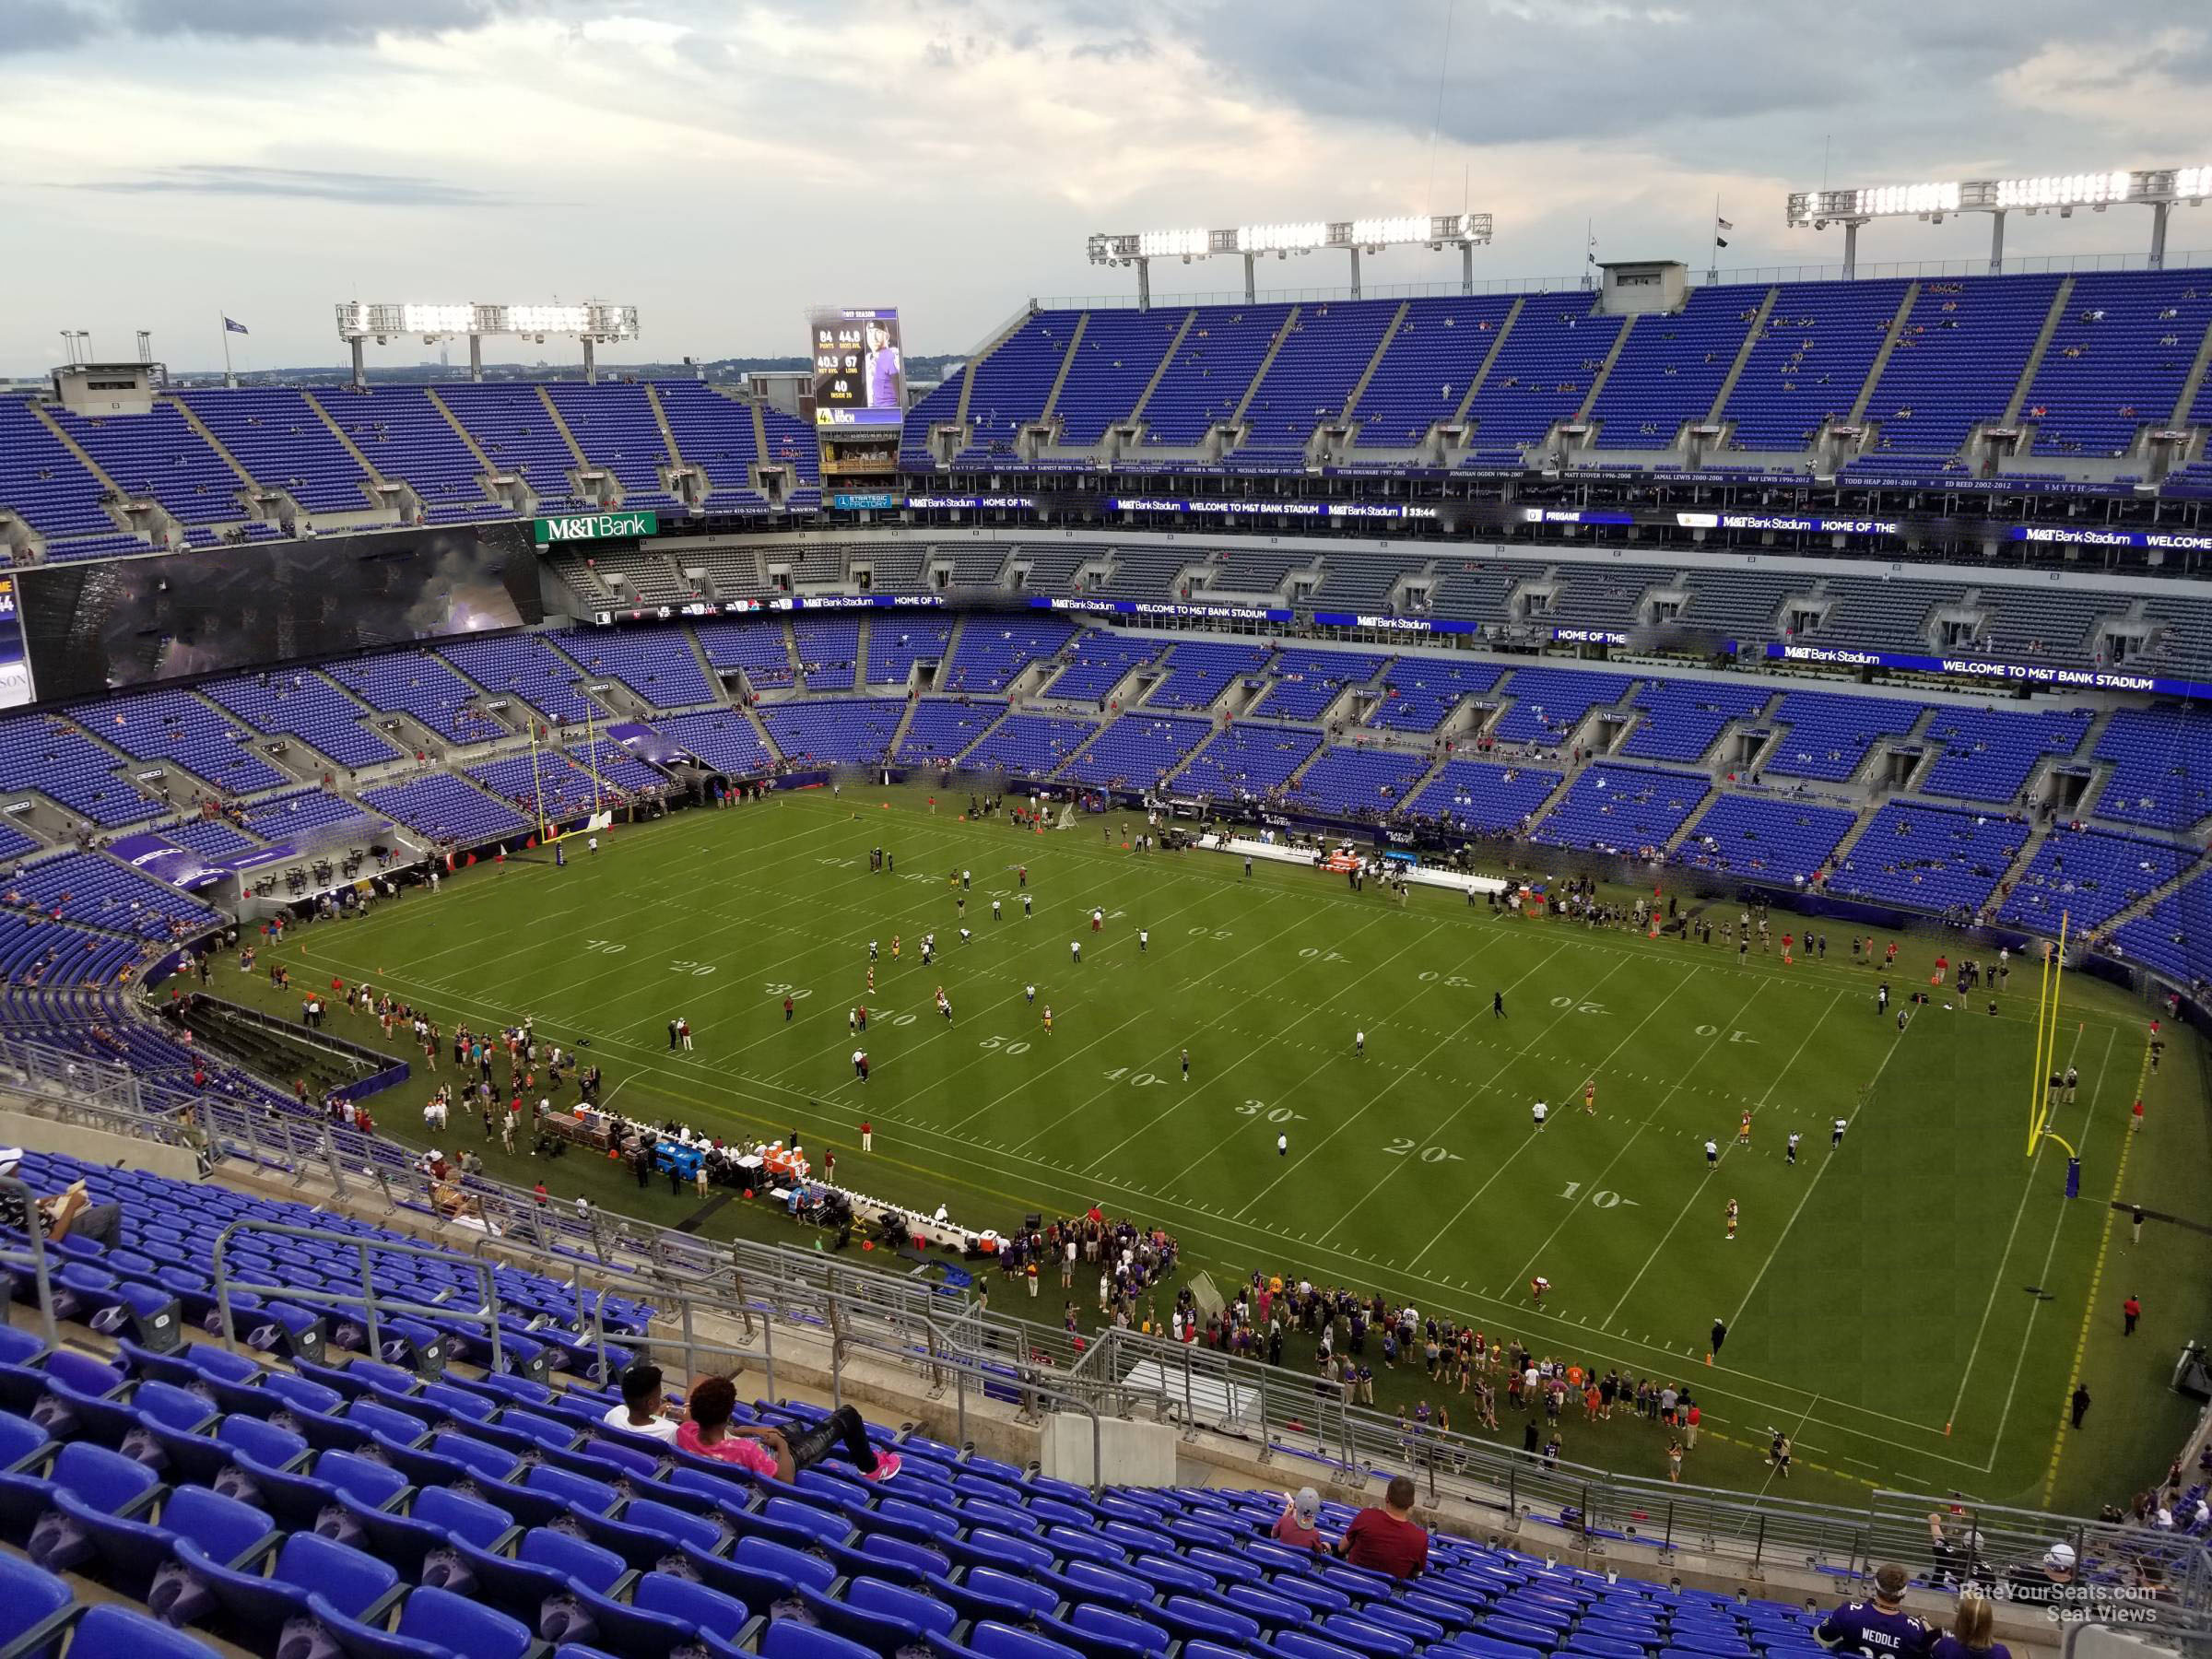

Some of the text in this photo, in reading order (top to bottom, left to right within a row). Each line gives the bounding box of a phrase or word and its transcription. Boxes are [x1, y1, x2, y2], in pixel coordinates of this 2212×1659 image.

[818, 356, 839, 367] 40.3
[835, 381, 848, 393] 40
[820, 411, 828, 423] 4
[835, 415, 855, 423] KOCH
[909, 499, 976, 507] M&T Bank Stadium
[982, 499, 1006, 507] HOME
[1007, 499, 1018, 507] OF
[1117, 500, 1181, 511] M&T Bank Stadium
[1189, 502, 1319, 513] WELCOME TO M&T BANK STADIUM
[1329, 505, 1398, 516] M&T Bank Stadium
[1409, 509, 1435, 517] 33:44
[1547, 512, 1580, 522] PREGAME
[547, 514, 647, 540] M&T Bank
[1724, 516, 1811, 530] M&T Bank Stadium
[1821, 521, 1895, 533] HOME OF THE
[2026, 529, 2130, 545] M&T Bank Stadium
[2146, 535, 2212, 549] WELCOME
[803, 597, 874, 607] M&T Bank Stadium
[1052, 599, 1115, 611] M&T Bank Stadium
[1135, 603, 1266, 618] WELCOME TO M&T BANK STADIUM
[1357, 616, 1430, 630] M&T Bank Stadium
[1559, 629, 1625, 643] HOME OF THE
[1784, 646, 1879, 665] M&T Bank Stadium
[1943, 660, 2153, 690] WELCOME TO M&T BANK STADIUM
[131, 848, 183, 866] GEICO
[587, 940, 627, 954] 10
[669, 960, 716, 976] 20
[765, 983, 813, 1001] 30
[979, 1036, 1030, 1054] 50
[1103, 1067, 1156, 1087] 40
[1235, 1100, 1294, 1123] 30
[1382, 1137, 1447, 1163] 20
[1555, 1182, 1620, 1209] 10
[1862, 1627, 1900, 1649] WEDDLE
